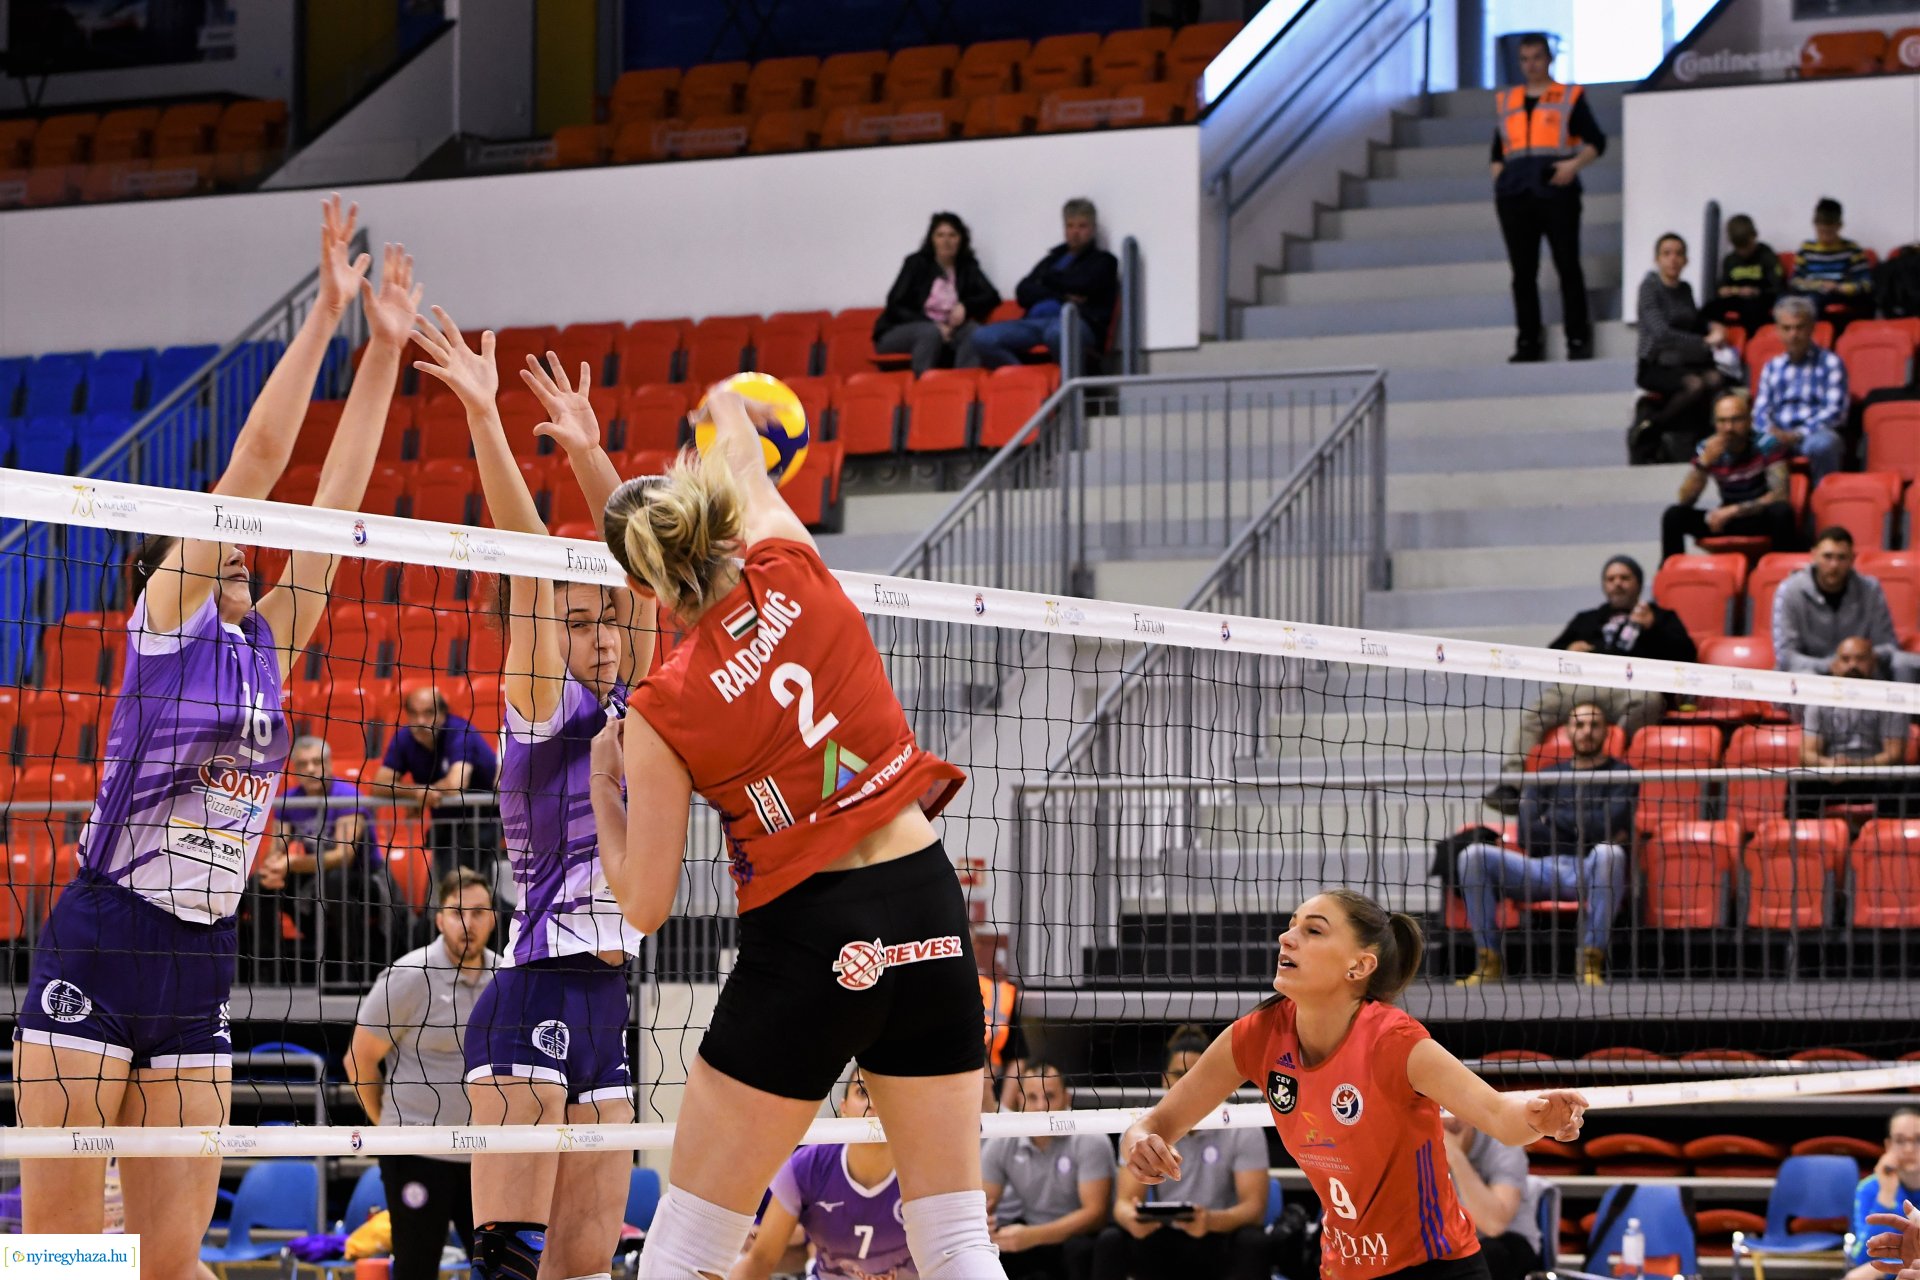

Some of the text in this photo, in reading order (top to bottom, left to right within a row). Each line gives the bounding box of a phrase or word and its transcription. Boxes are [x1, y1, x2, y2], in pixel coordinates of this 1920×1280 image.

[240, 681, 272, 746] 16
[769, 662, 840, 749] 2
[198, 755, 275, 807] Capri
[206, 795, 242, 819] Pizzeria
[885, 939, 961, 965] REVESZ
[1275, 1075, 1291, 1085] CEV
[72, 1132, 114, 1151] FATUM
[452, 1131, 487, 1149] FATUM
[1328, 1176, 1358, 1220] 9
[854, 1224, 874, 1260] 7
